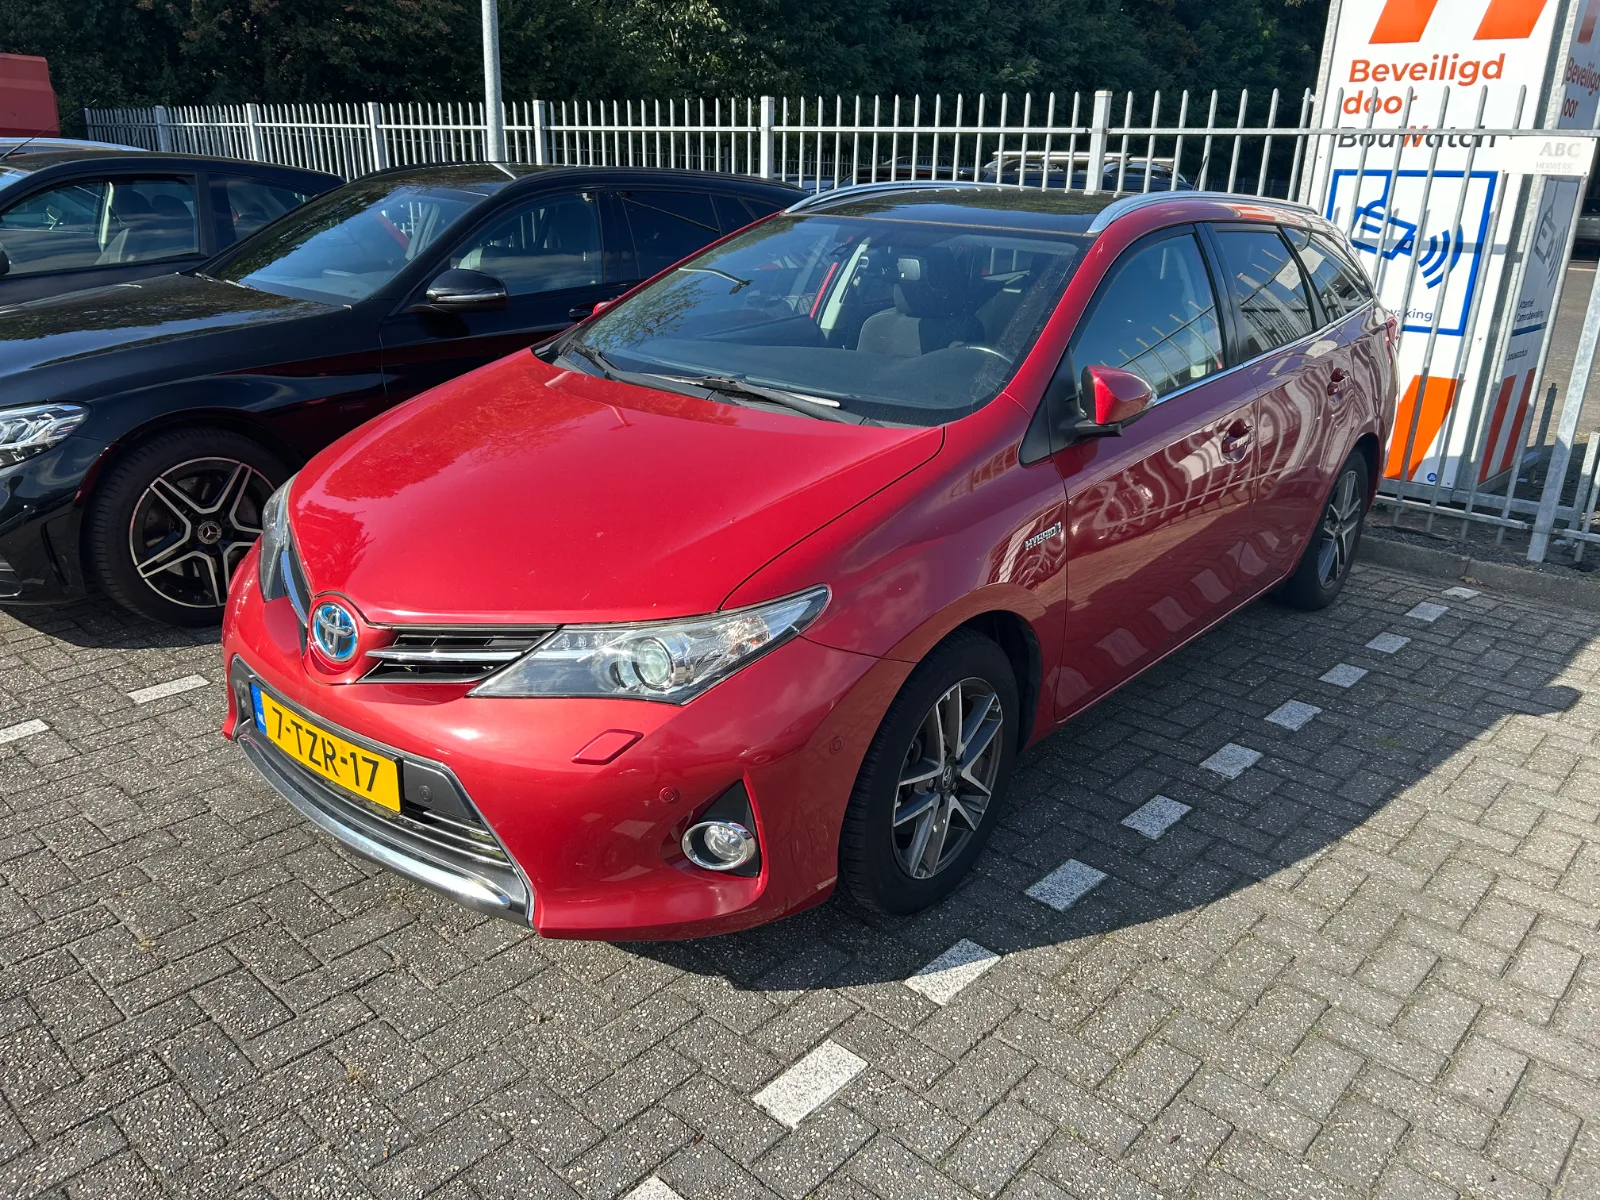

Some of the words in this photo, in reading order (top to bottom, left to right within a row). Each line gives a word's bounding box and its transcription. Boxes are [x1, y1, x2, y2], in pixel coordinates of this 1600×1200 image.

[1349, 53, 1506, 87] Beveiligd
[1564, 98, 1579, 118] oor
[1539, 142, 1581, 157] ABC
[1025, 526, 1056, 550] HYBRID
[272, 706, 379, 792] 7-TZR-17
